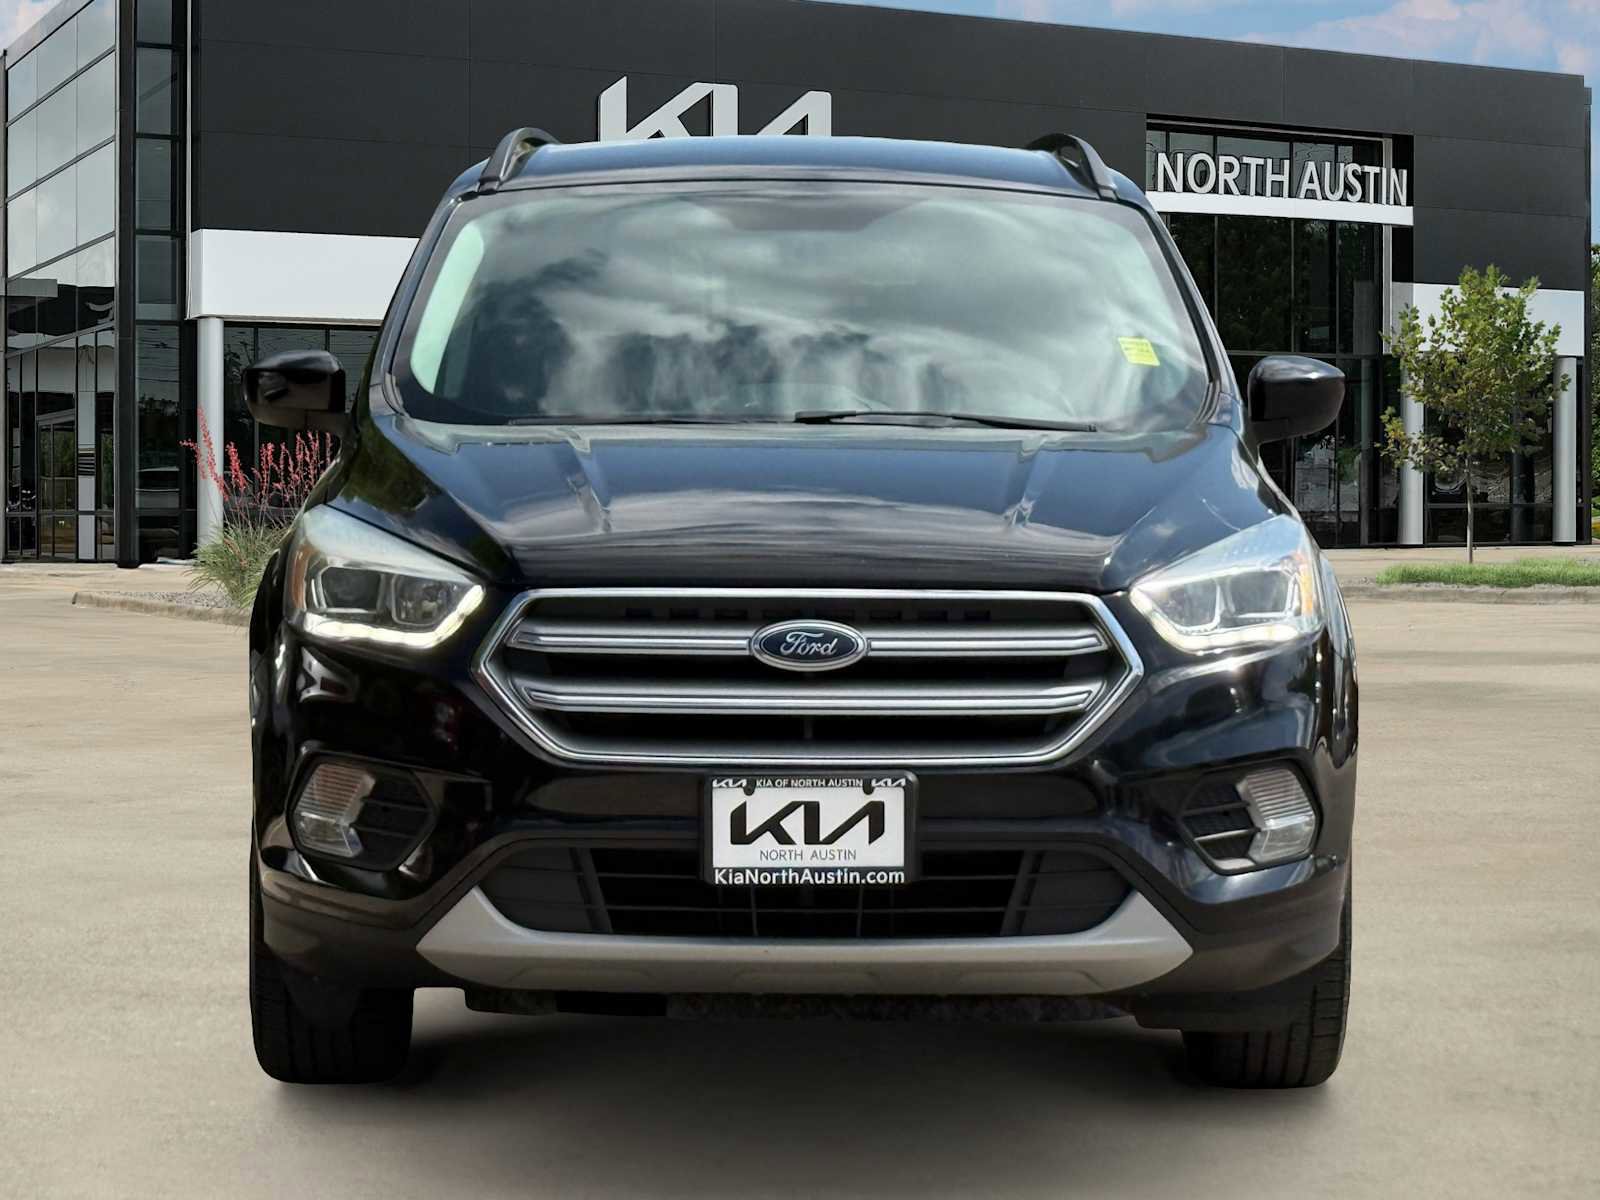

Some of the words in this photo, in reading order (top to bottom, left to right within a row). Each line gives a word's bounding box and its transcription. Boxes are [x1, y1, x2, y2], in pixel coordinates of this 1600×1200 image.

[1156, 152, 1290, 199] NORTH
[1299, 160, 1408, 206] AUSTIN
[780, 631, 838, 656] Ford
[756, 779, 773, 787] KIA
[775, 779, 788, 787] OF
[791, 779, 825, 787] NORTH
[828, 779, 863, 787] AUSTIN
[730, 801, 885, 845] KIA
[759, 849, 803, 861] NORTH
[810, 849, 857, 861] AUSTIN
[714, 868, 905, 885] KiaNorthAustin.com
